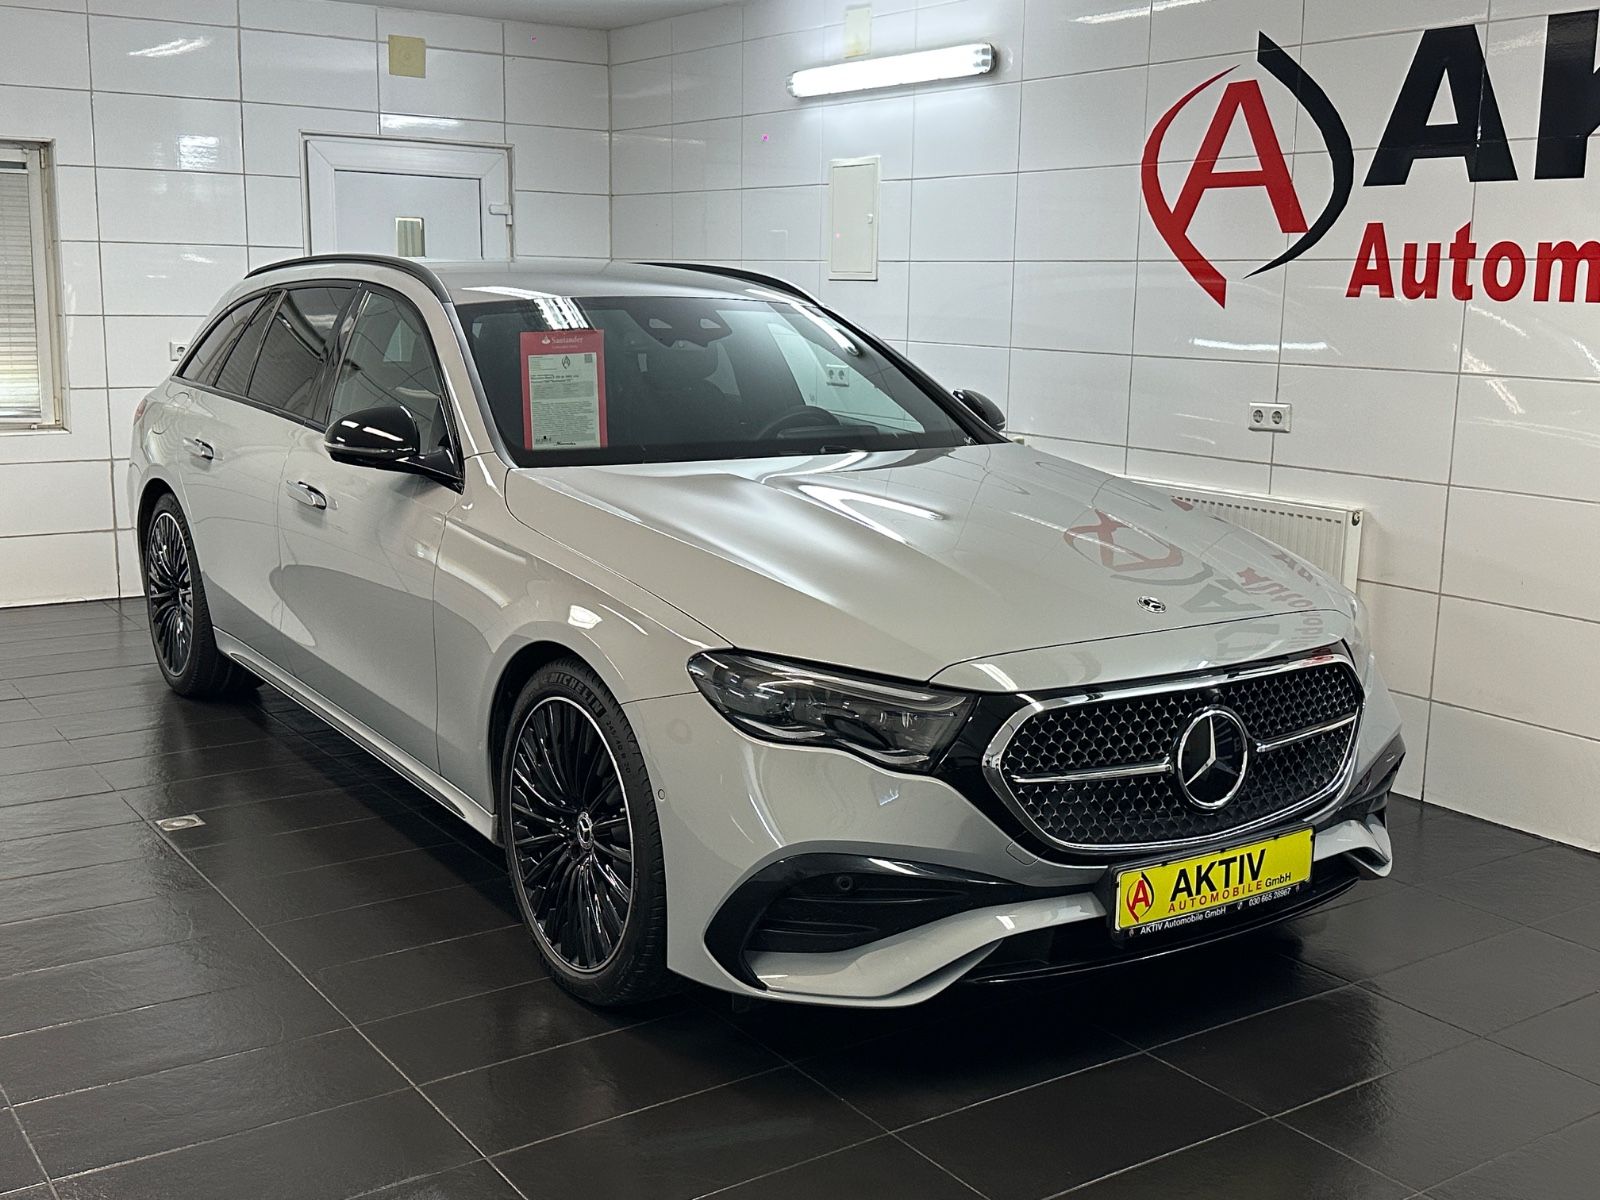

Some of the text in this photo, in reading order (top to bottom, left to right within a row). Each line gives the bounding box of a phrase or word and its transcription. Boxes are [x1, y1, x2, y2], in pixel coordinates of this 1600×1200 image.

[1345, 221, 1600, 302] Autom
[548, 672, 606, 717] MICHELIN
[1168, 872, 1291, 913] AUTOMOBILE GmbH
[1170, 849, 1266, 902] AKTIV
[1140, 923, 1163, 935] AKTIV
[1164, 915, 1203, 929] Automobile
[1205, 906, 1226, 919] GmbH
